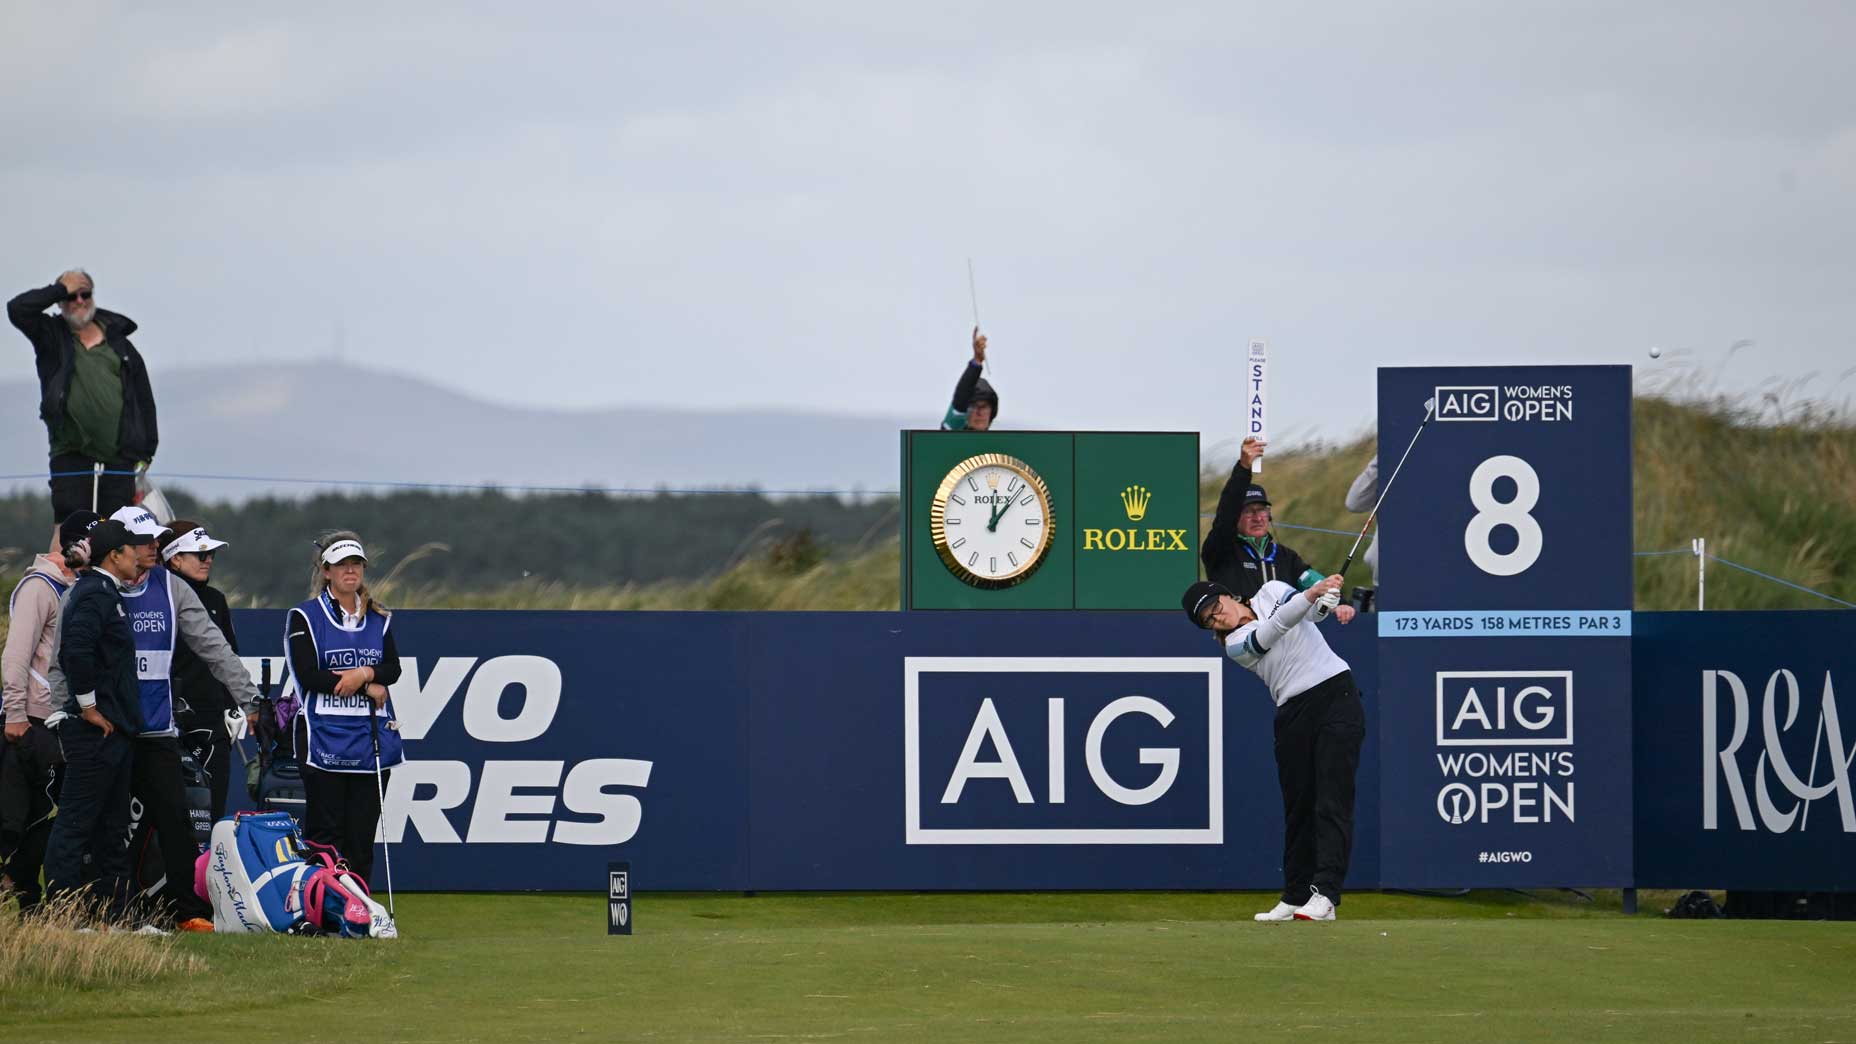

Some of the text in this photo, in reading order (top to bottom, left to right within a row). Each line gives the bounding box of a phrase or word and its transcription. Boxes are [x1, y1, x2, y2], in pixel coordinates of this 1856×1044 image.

[1251, 365, 1263, 433] STAND
[1442, 385, 1573, 414] AIG WOMEN'S
[1504, 400, 1573, 421] OPEN
[1464, 454, 1543, 576] 8
[1083, 528, 1189, 551] ROLEX
[133, 611, 164, 619] WOMEN'S
[133, 620, 166, 632] OPEN
[1395, 616, 1621, 630] 173 YARDS 158 METRES PAR 3
[329, 652, 354, 666] AIG
[1451, 686, 1555, 730] AIG
[940, 695, 1181, 805] AIG
[1702, 668, 1856, 834] R&A
[1436, 752, 1574, 777] WOMEN'S
[1436, 782, 1575, 825] OPEN
[1478, 852, 1532, 863] #AIGWO
[612, 876, 625, 893] AIG
[610, 903, 628, 926] WO
